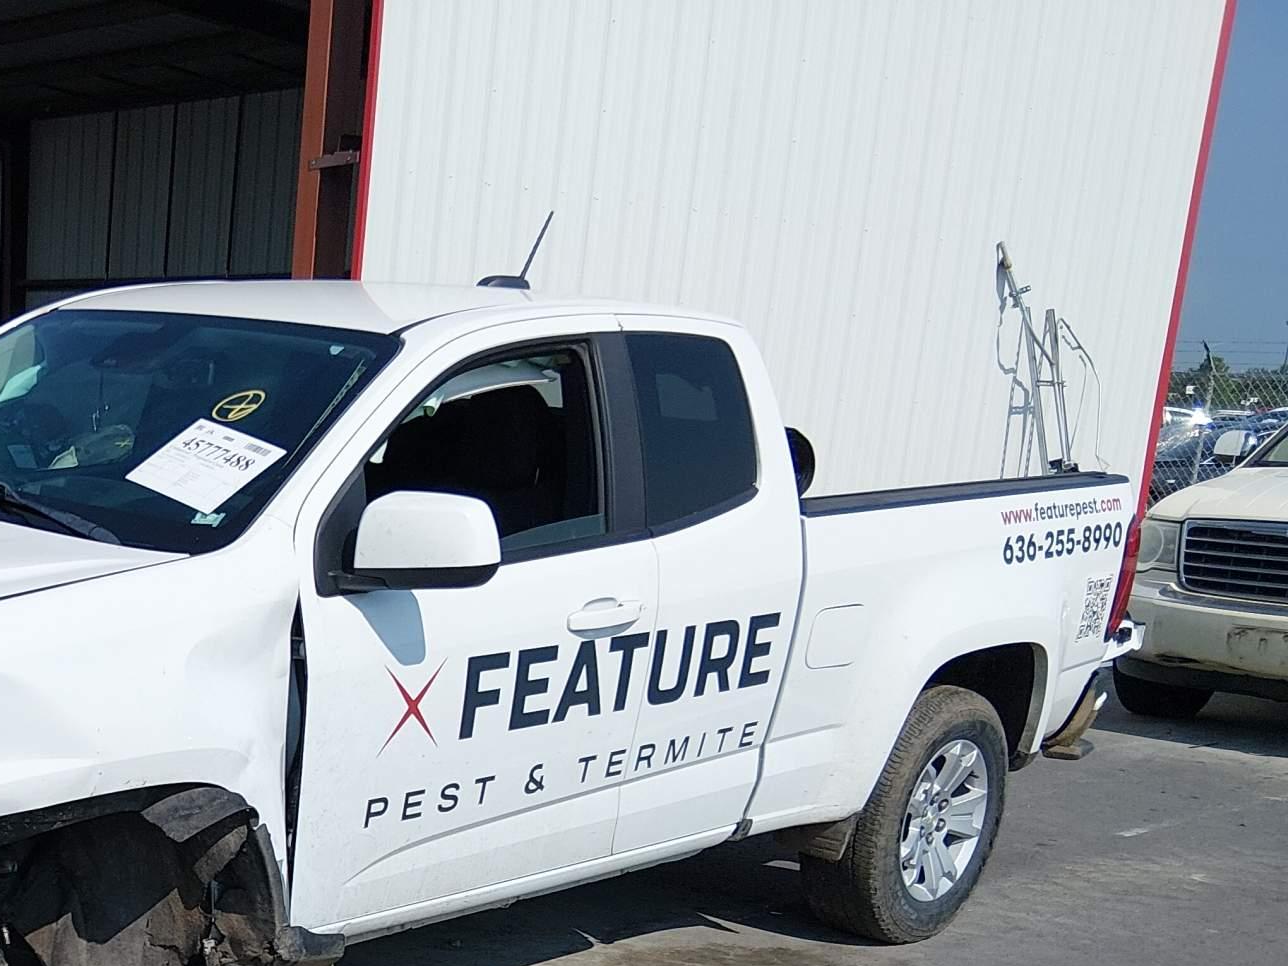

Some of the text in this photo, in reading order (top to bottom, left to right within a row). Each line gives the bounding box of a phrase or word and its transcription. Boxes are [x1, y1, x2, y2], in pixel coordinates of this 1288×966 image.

[182, 436, 256, 472] 45777488
[1001, 498, 1121, 525] www.featurepest.com
[1003, 522, 1122, 564] 636-255-8990
[458, 612, 782, 740] FEATURE
[363, 720, 759, 829] PEST & TERMITE
